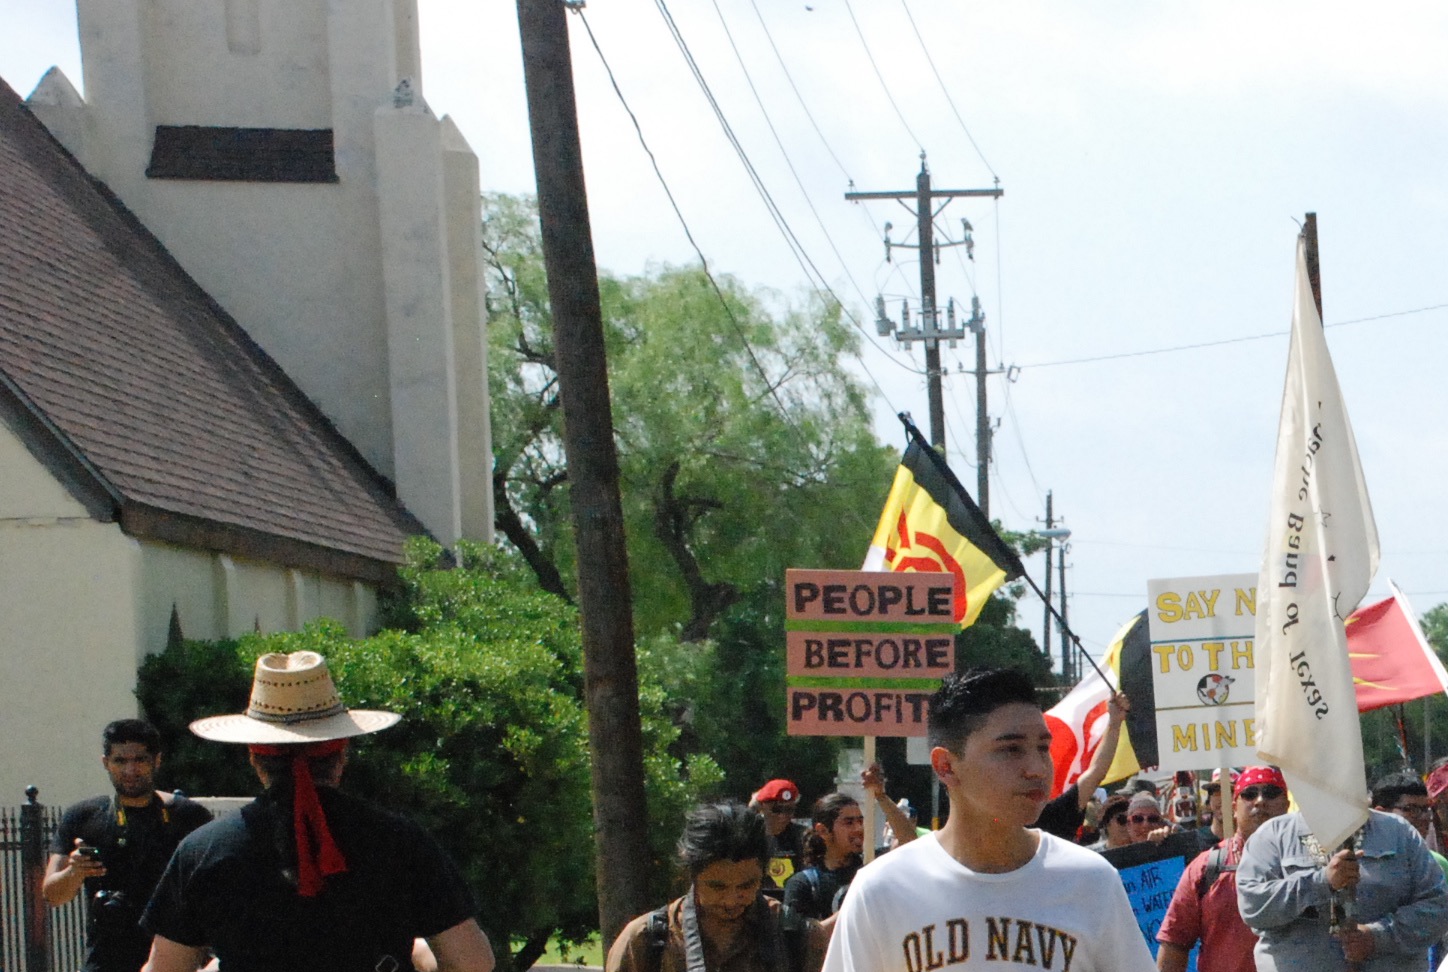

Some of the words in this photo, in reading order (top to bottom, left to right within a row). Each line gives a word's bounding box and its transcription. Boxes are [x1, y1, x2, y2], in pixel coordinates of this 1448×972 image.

[794, 582, 952, 616] PEOPLE
[1156, 589, 1220, 623] SAY
[1234, 588, 1257, 616] N
[804, 638, 950, 669] BEFORE
[1153, 644, 1194, 673] TO
[1202, 641, 1255, 671] TH
[791, 691, 929, 723] PROFIT
